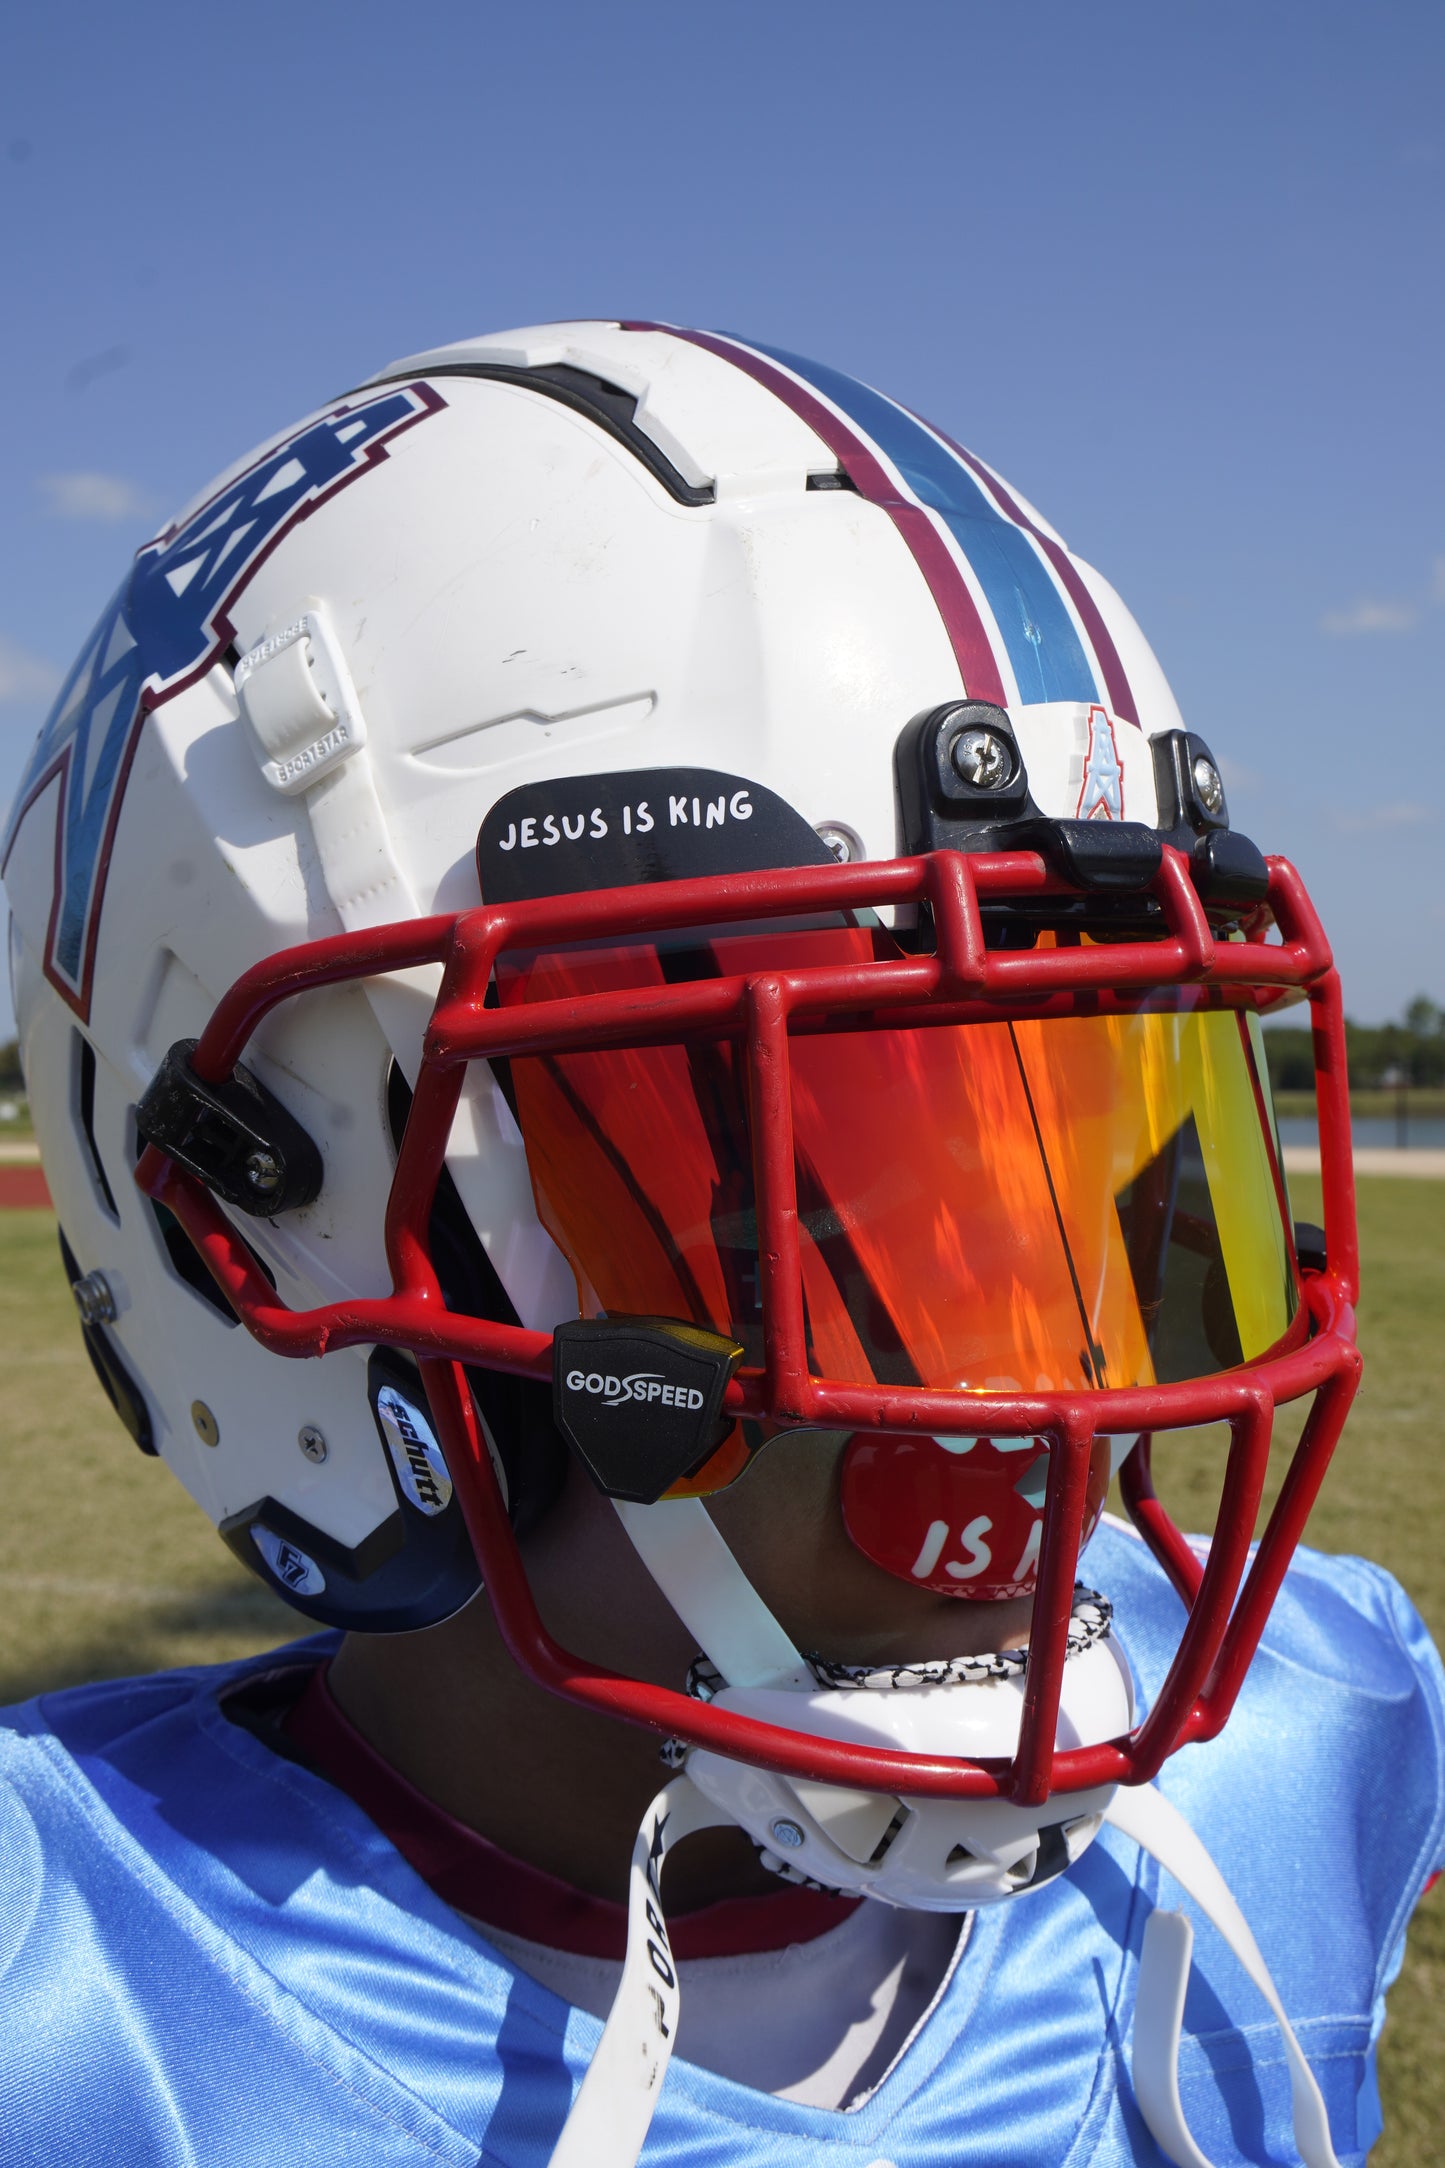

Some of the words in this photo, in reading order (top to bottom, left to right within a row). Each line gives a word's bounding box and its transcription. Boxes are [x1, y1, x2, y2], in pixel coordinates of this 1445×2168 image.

[277, 726, 349, 782] SPORTSTAR
[499, 807, 608, 851] JESUS
[623, 801, 655, 835] IS
[668, 790, 753, 829] KING
[388, 1400, 444, 1508] schutt
[276, 1539, 310, 1588] F7
[911, 1514, 993, 1579] IS
